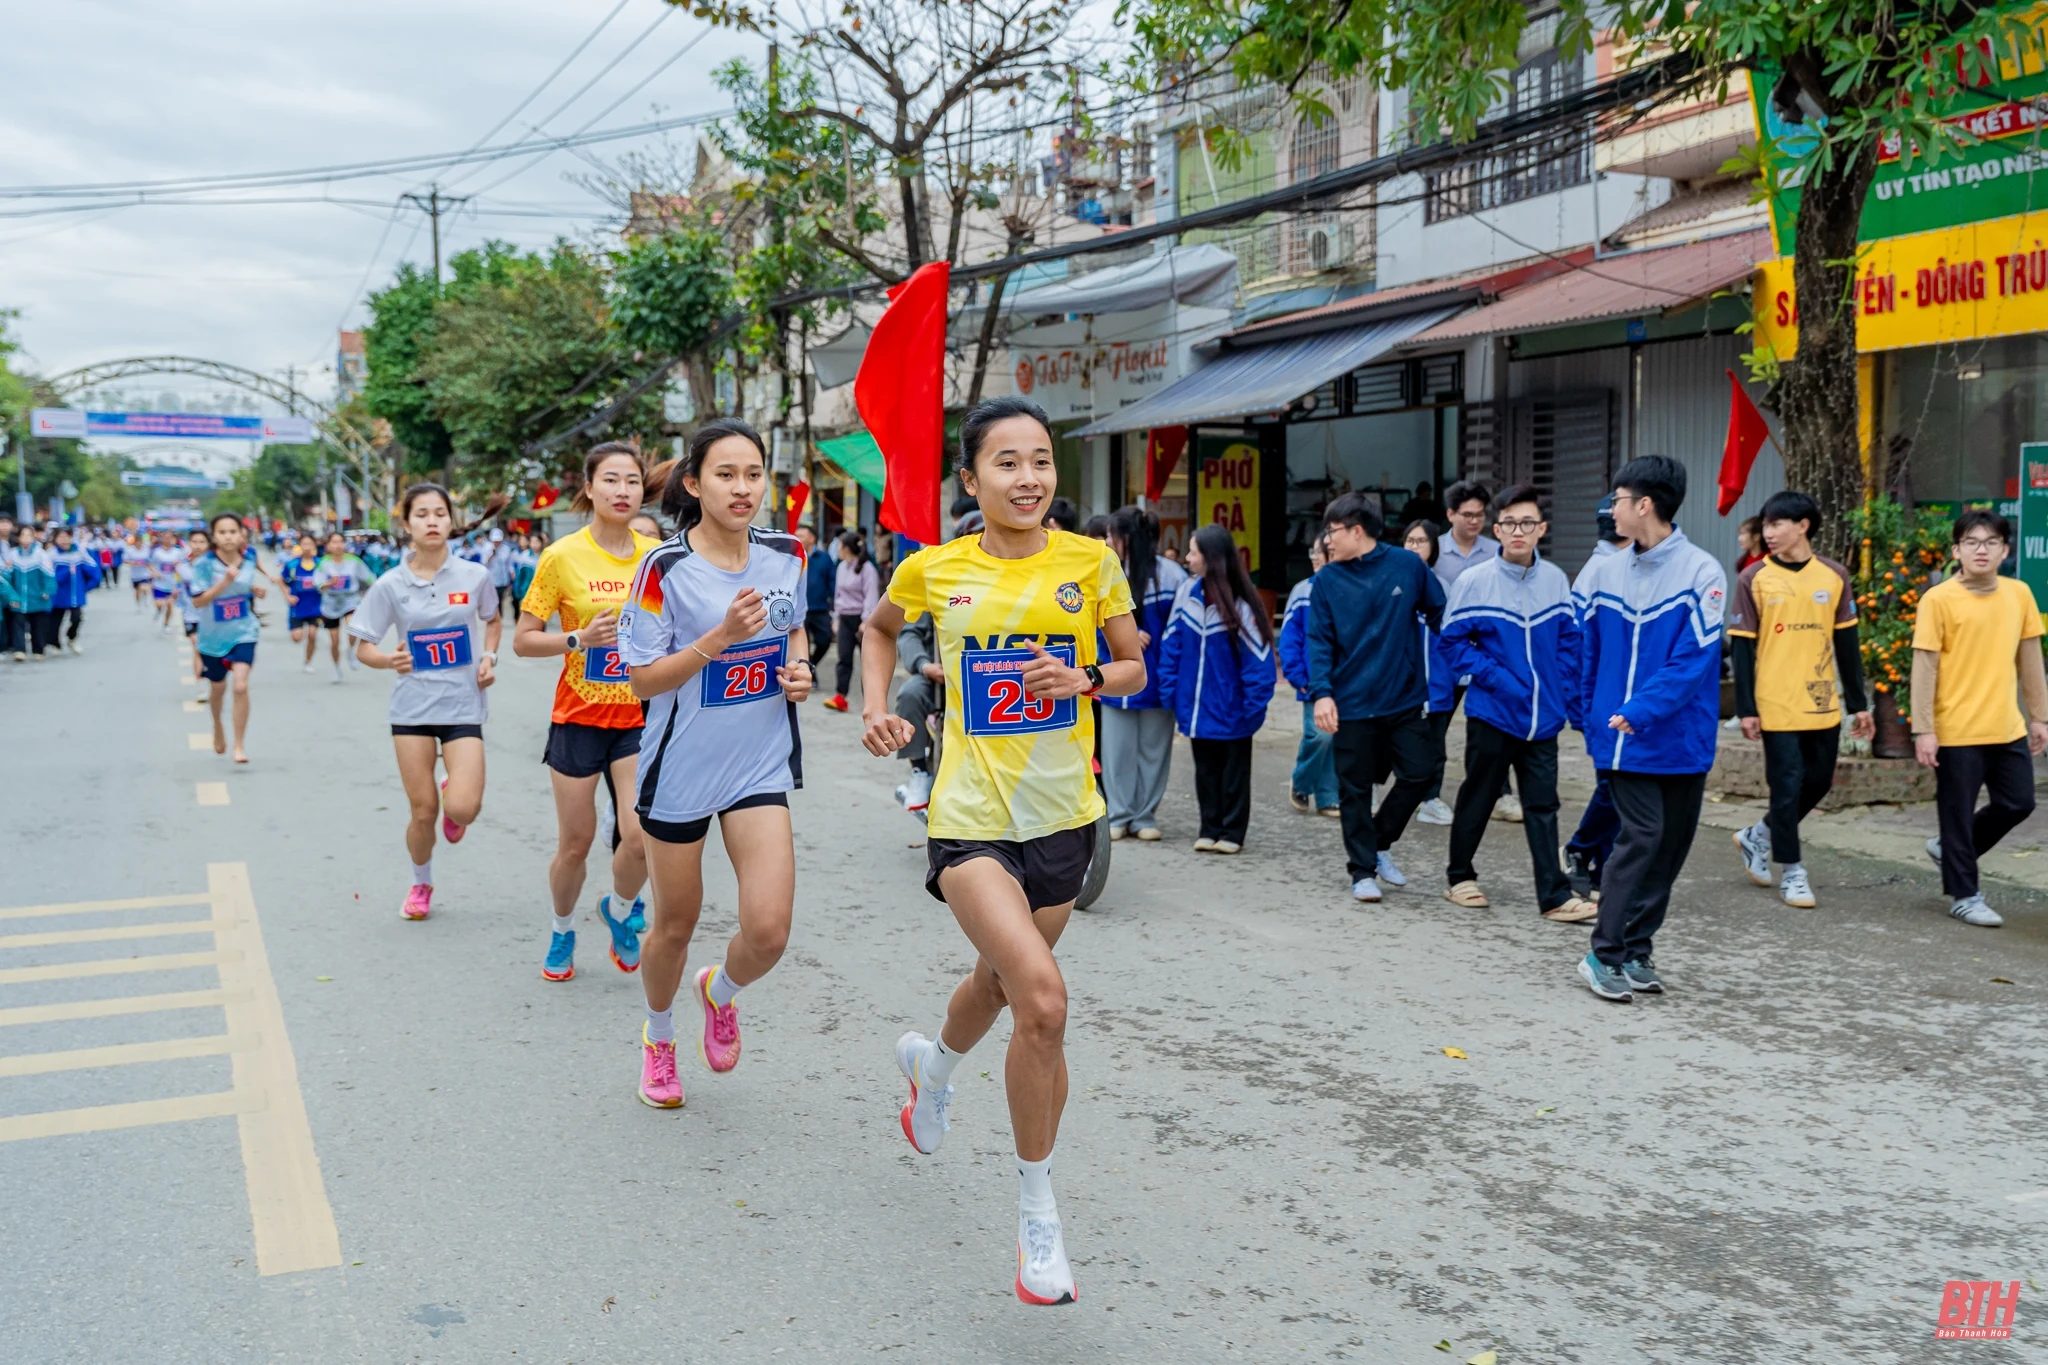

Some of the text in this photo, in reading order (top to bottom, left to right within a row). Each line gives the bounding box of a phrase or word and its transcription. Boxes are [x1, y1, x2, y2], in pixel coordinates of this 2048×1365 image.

[1970, 108, 2012, 135] KẾT
[1875, 177, 1905, 201] UY
[1908, 166, 1950, 194] TÍN
[1952, 158, 2001, 190] TẠO
[1916, 256, 1986, 308] ĐÔNG
[1203, 448, 1254, 490] PHỞ
[1213, 496, 1246, 533] GÀ
[589, 581, 625, 593] HOP
[426, 641, 456, 665] 11
[603, 650, 630, 677] 2
[724, 660, 767, 699] 26
[988, 679, 1056, 725] 25
